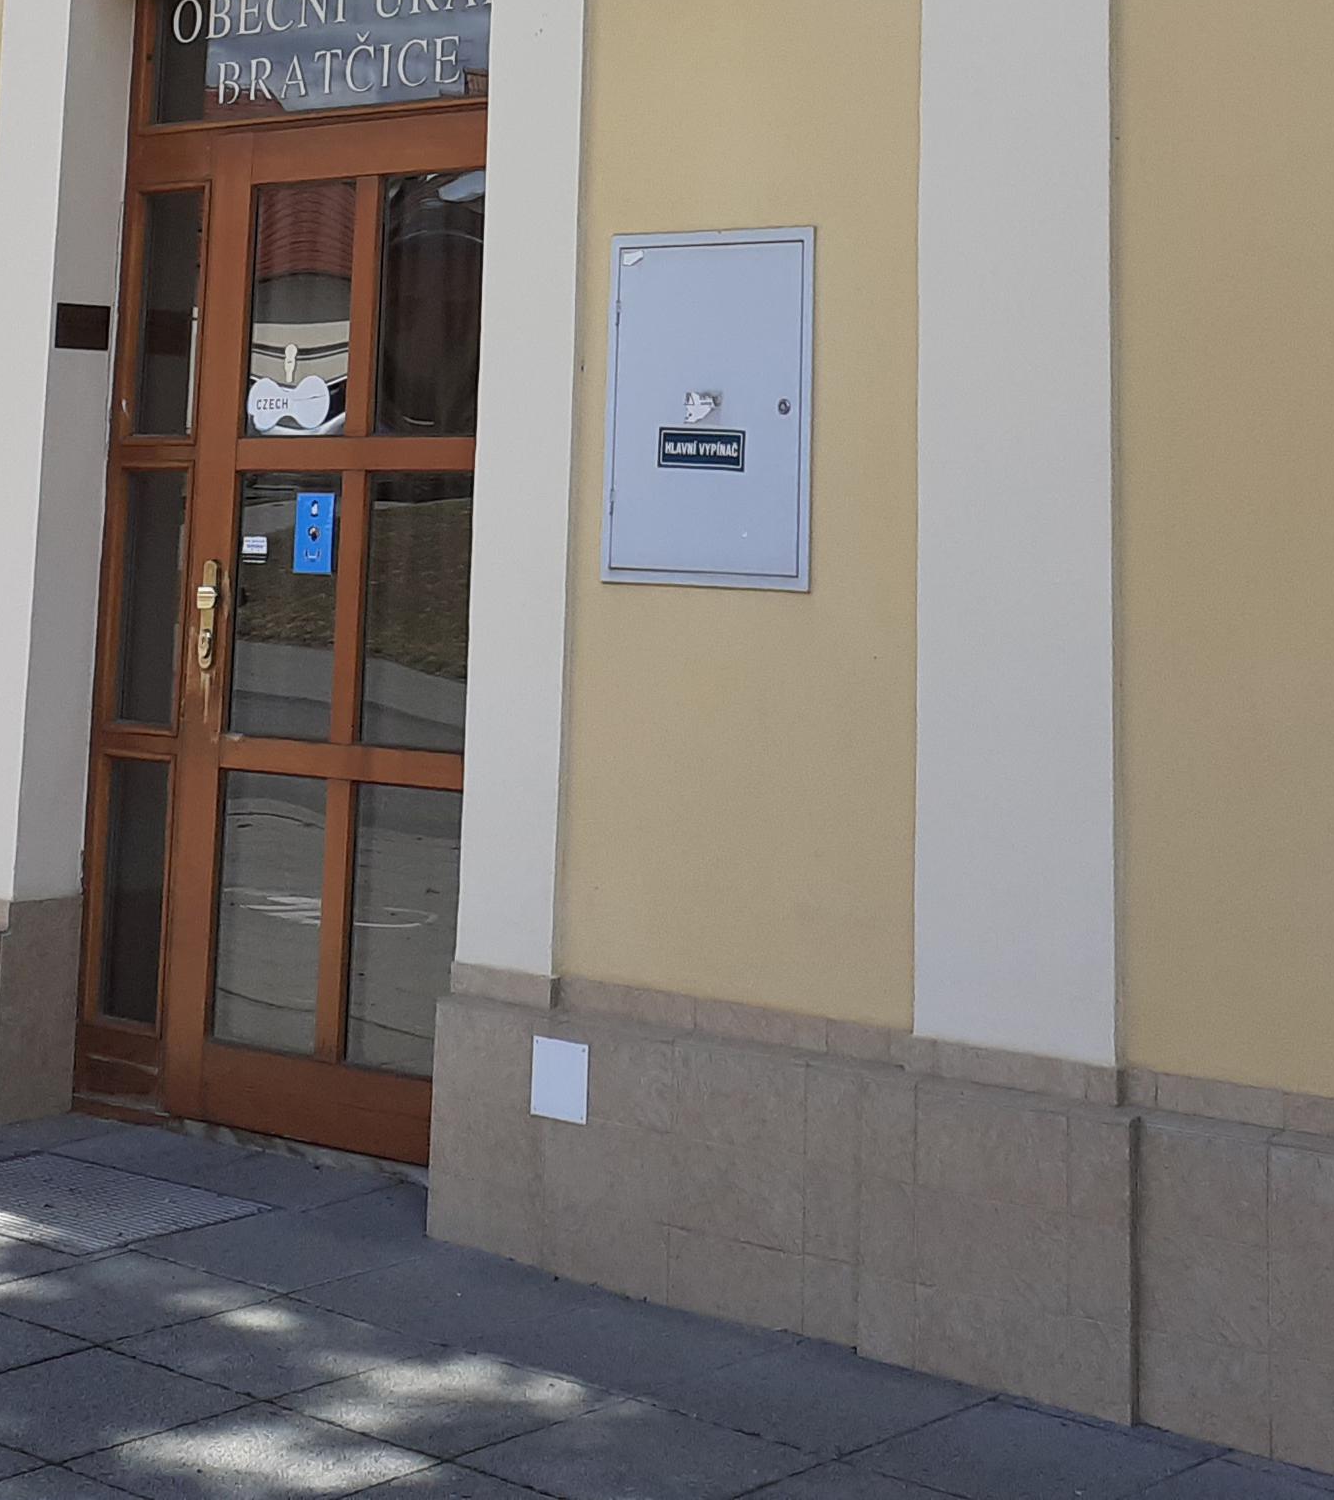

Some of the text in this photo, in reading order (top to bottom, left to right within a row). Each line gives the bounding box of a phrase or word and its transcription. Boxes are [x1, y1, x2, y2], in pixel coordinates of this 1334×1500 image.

[217, 31, 462, 106] BRATČICE
[256, 399, 289, 410] CZECH
[665, 440, 739, 457] HLAVNÍ VYPÍNAČ
